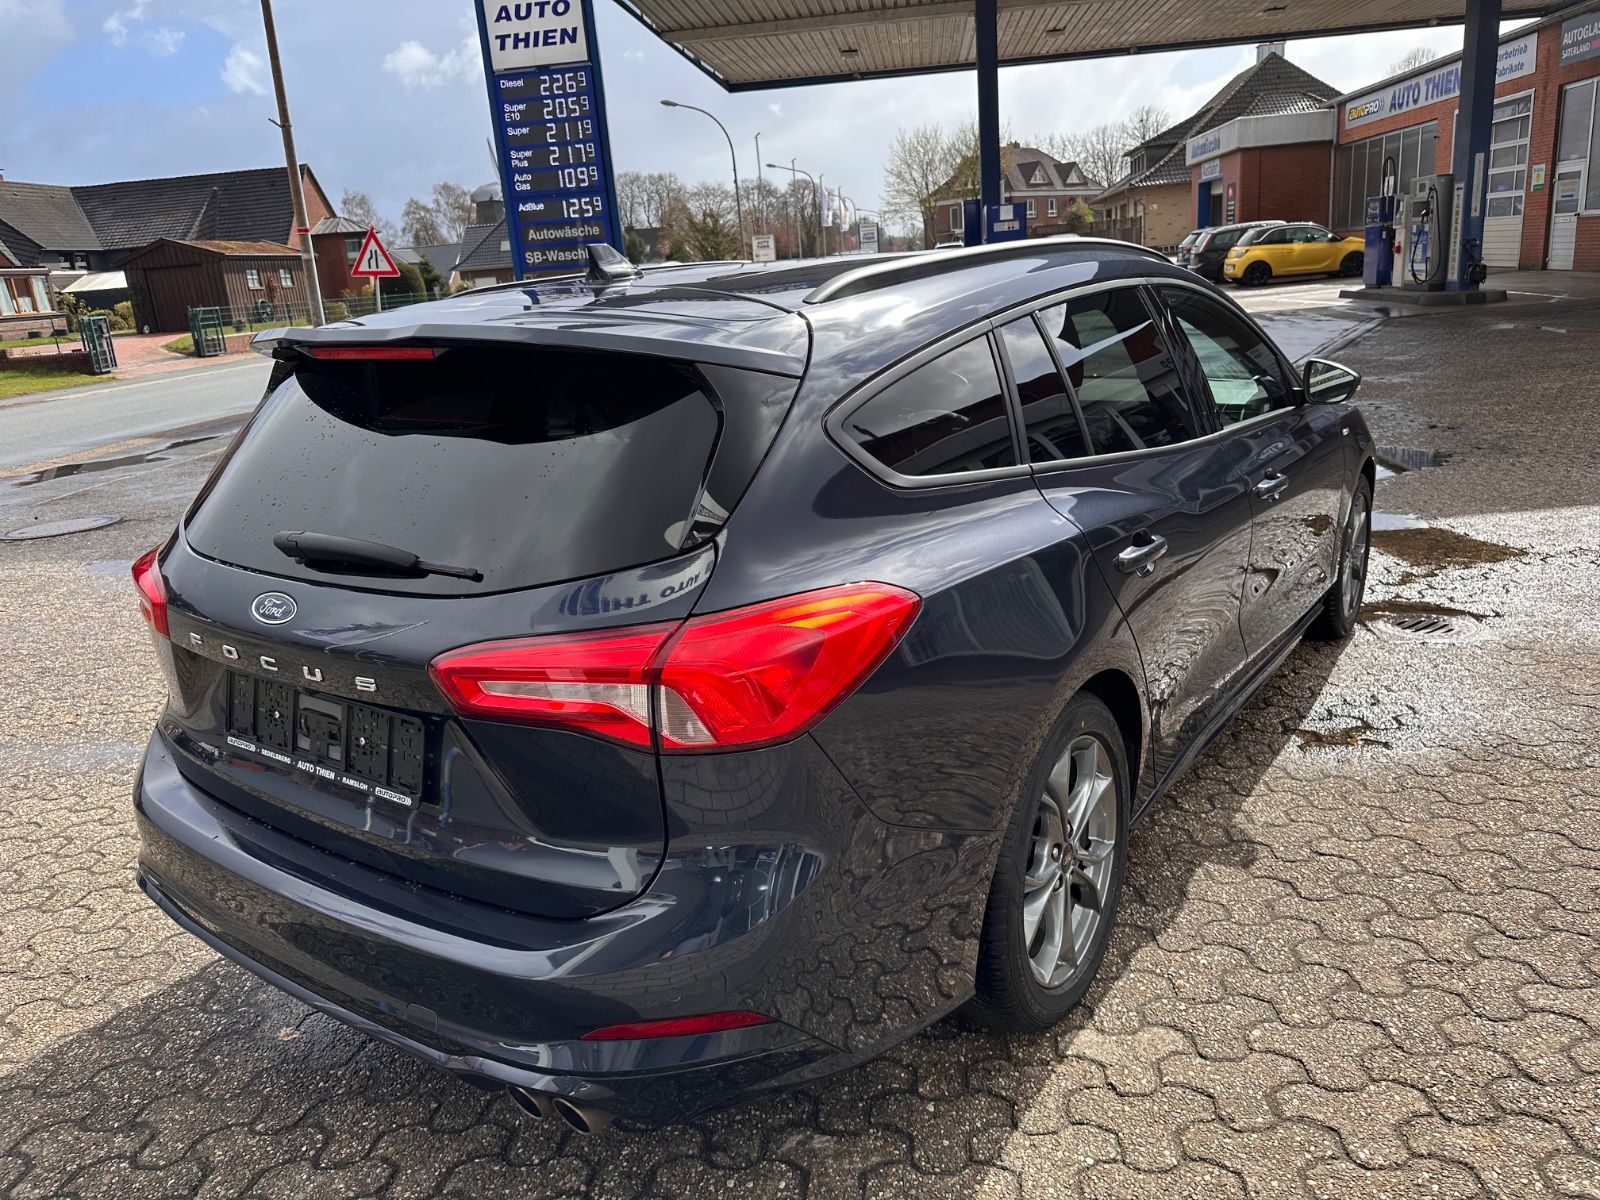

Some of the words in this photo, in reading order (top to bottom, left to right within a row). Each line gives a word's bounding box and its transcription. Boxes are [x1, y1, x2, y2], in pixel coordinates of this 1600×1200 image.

[494, 0, 570, 23] AUTO
[494, 26, 578, 51] THIEN
[500, 78, 524, 89] Diesel
[1389, 82, 1421, 113] AUTO
[504, 103, 527, 113] Super
[505, 113, 521, 122] E10
[507, 127, 530, 137] Super
[510, 150, 533, 160] Super
[511, 160, 529, 168] Plus
[514, 173, 532, 182] Auto
[515, 182, 531, 191] Gas
[518, 202, 545, 212] AdBlue
[527, 225, 600, 241] Autowäsche
[525, 248, 590, 264] SB-Wasch
[259, 597, 287, 617] Ford
[189, 632, 377, 692] FOCUS
[297, 760, 315, 773] AUTO
[315, 766, 336, 780] THIEN
[342, 776, 368, 791] RAMSLOH
